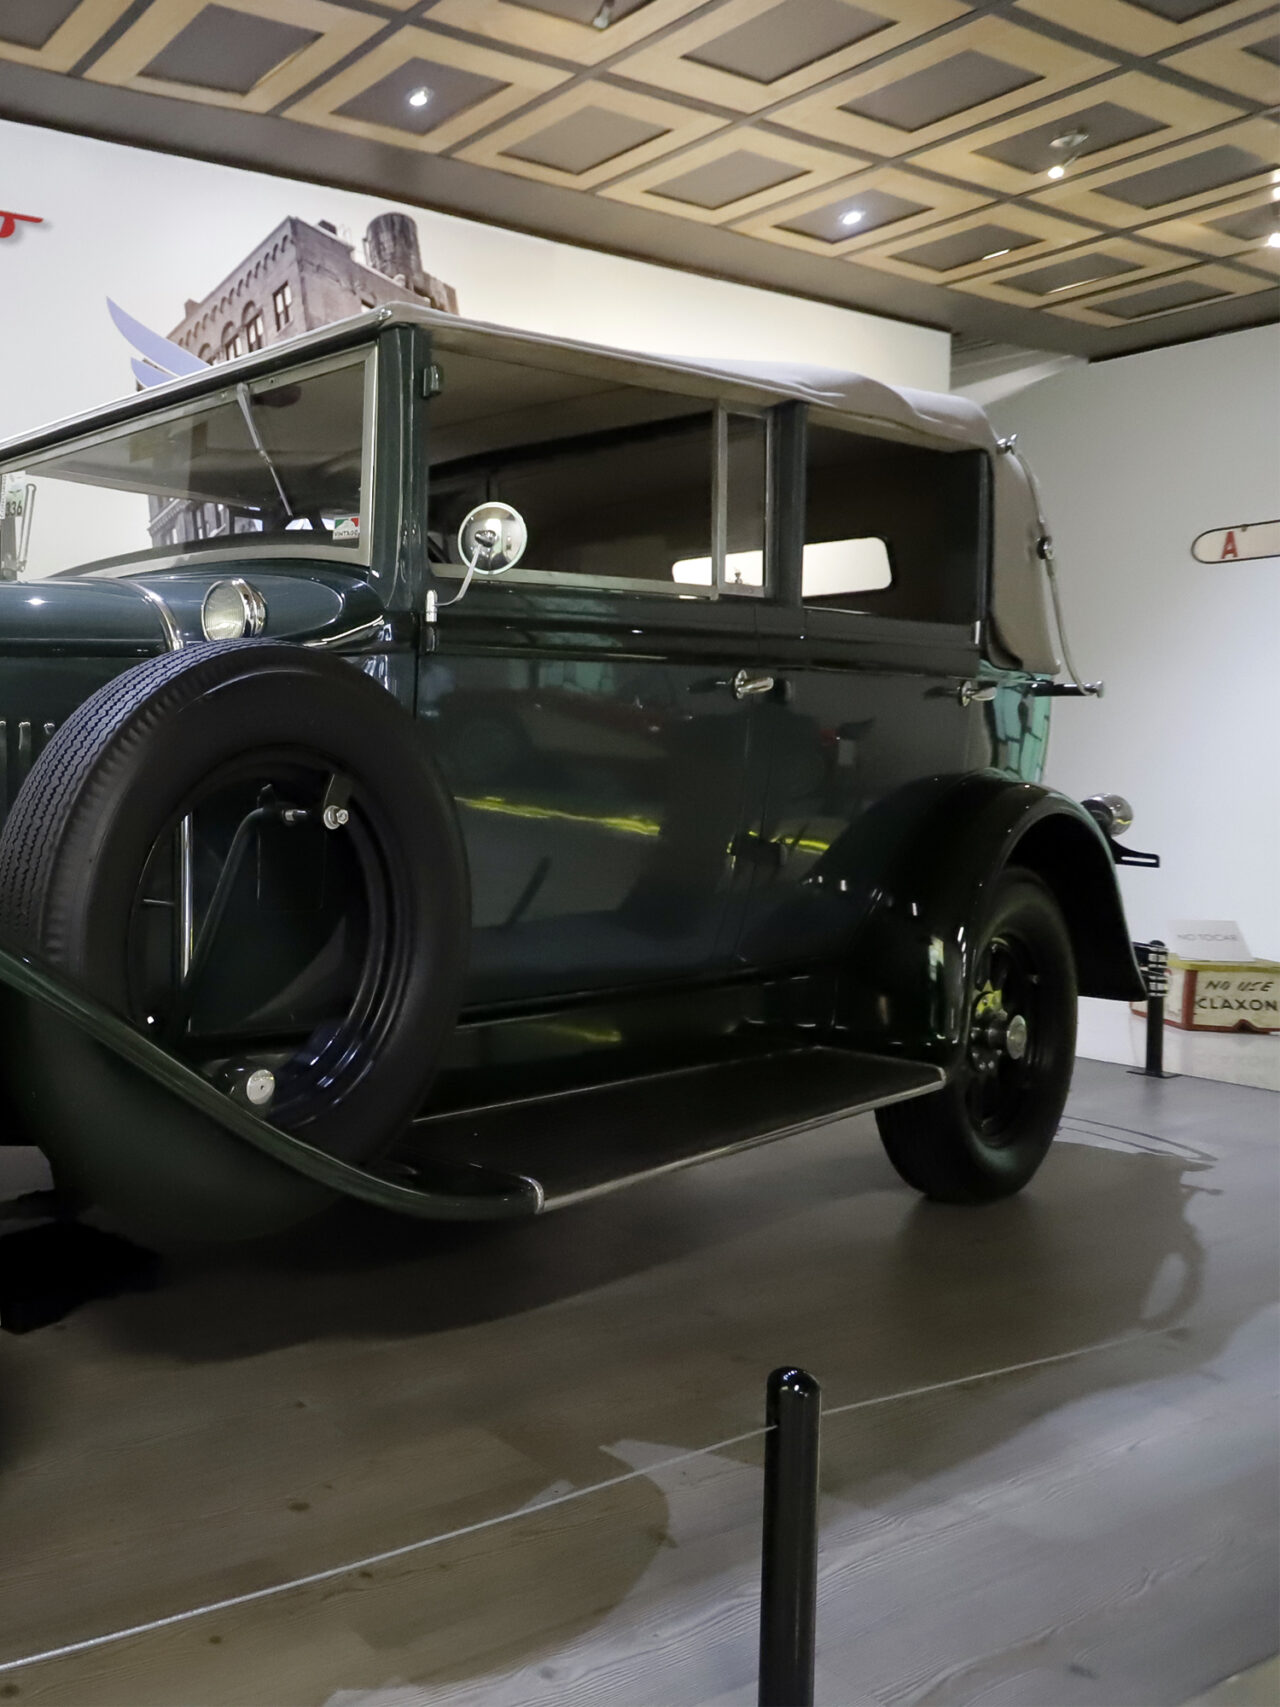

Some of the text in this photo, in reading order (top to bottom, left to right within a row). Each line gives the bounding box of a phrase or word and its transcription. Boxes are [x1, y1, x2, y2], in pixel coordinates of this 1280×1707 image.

[1221, 530, 1238, 559] A
[1177, 933, 1238, 942] NO TOCAR
[1205, 980, 1274, 993] NO USE
[1196, 997, 1278, 1012] CLAXON
